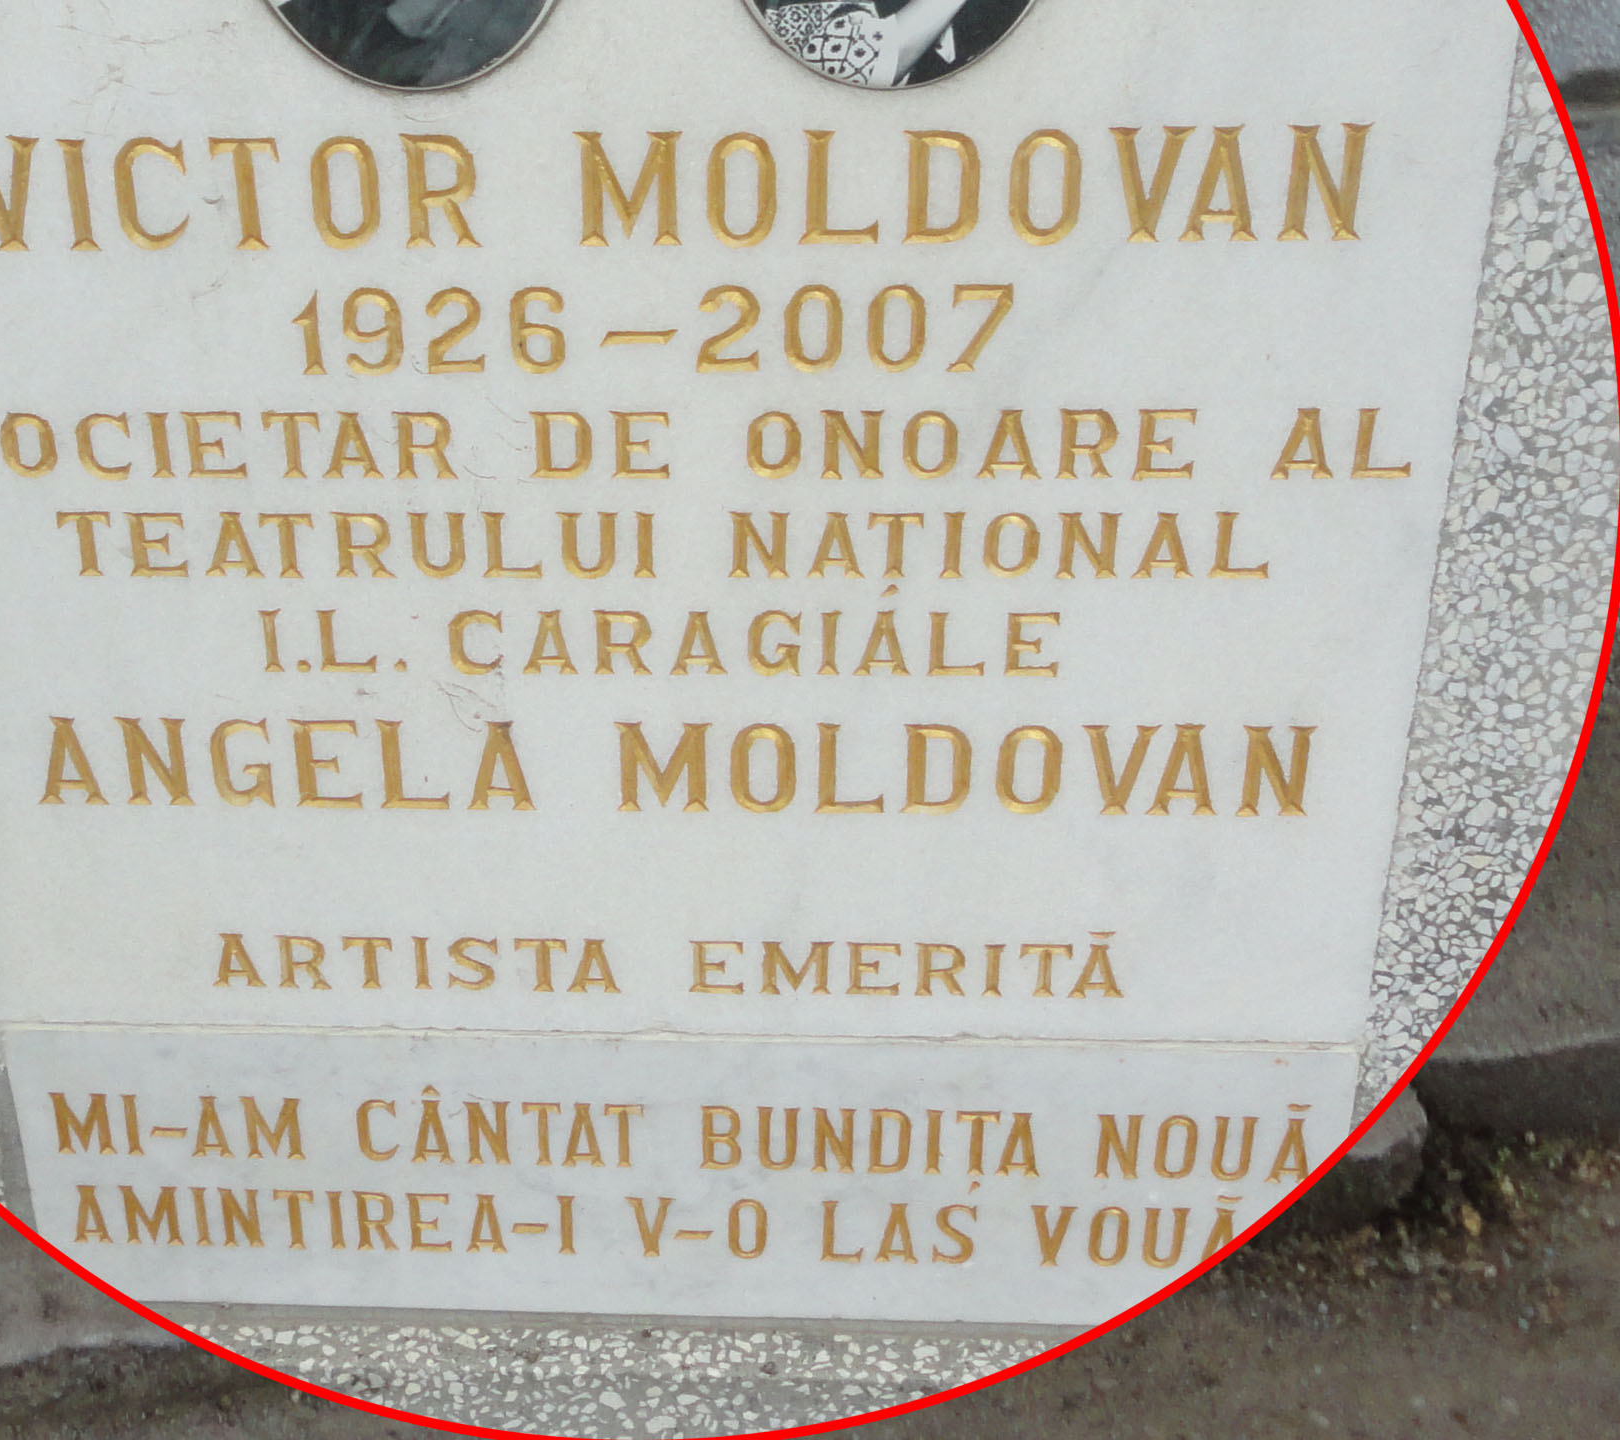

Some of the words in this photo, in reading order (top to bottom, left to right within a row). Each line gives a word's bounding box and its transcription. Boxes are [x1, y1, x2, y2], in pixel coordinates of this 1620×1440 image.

[573, 123, 1373, 248] MOLDOVAN
[529, 410, 671, 481] DE
[746, 408, 1197, 481] ONOARE
[1270, 408, 1412, 481] AL
[56, 511, 657, 580] TEATRULUI
[259, 610, 408, 674] I.L.
[39, 716, 538, 811] ANGELA
[614, 722, 1317, 818] MOLDOVAN
[213, 933, 622, 993] ARTISTA
[48, 1091, 306, 1161] MI-AM
[356, 1085, 645, 1168] CÂNTAT
[74, 1184, 577, 1254] AMINTIREA-I
[626, 1195, 768, 1260] V-O
[820, 1200, 978, 1264] LAS
